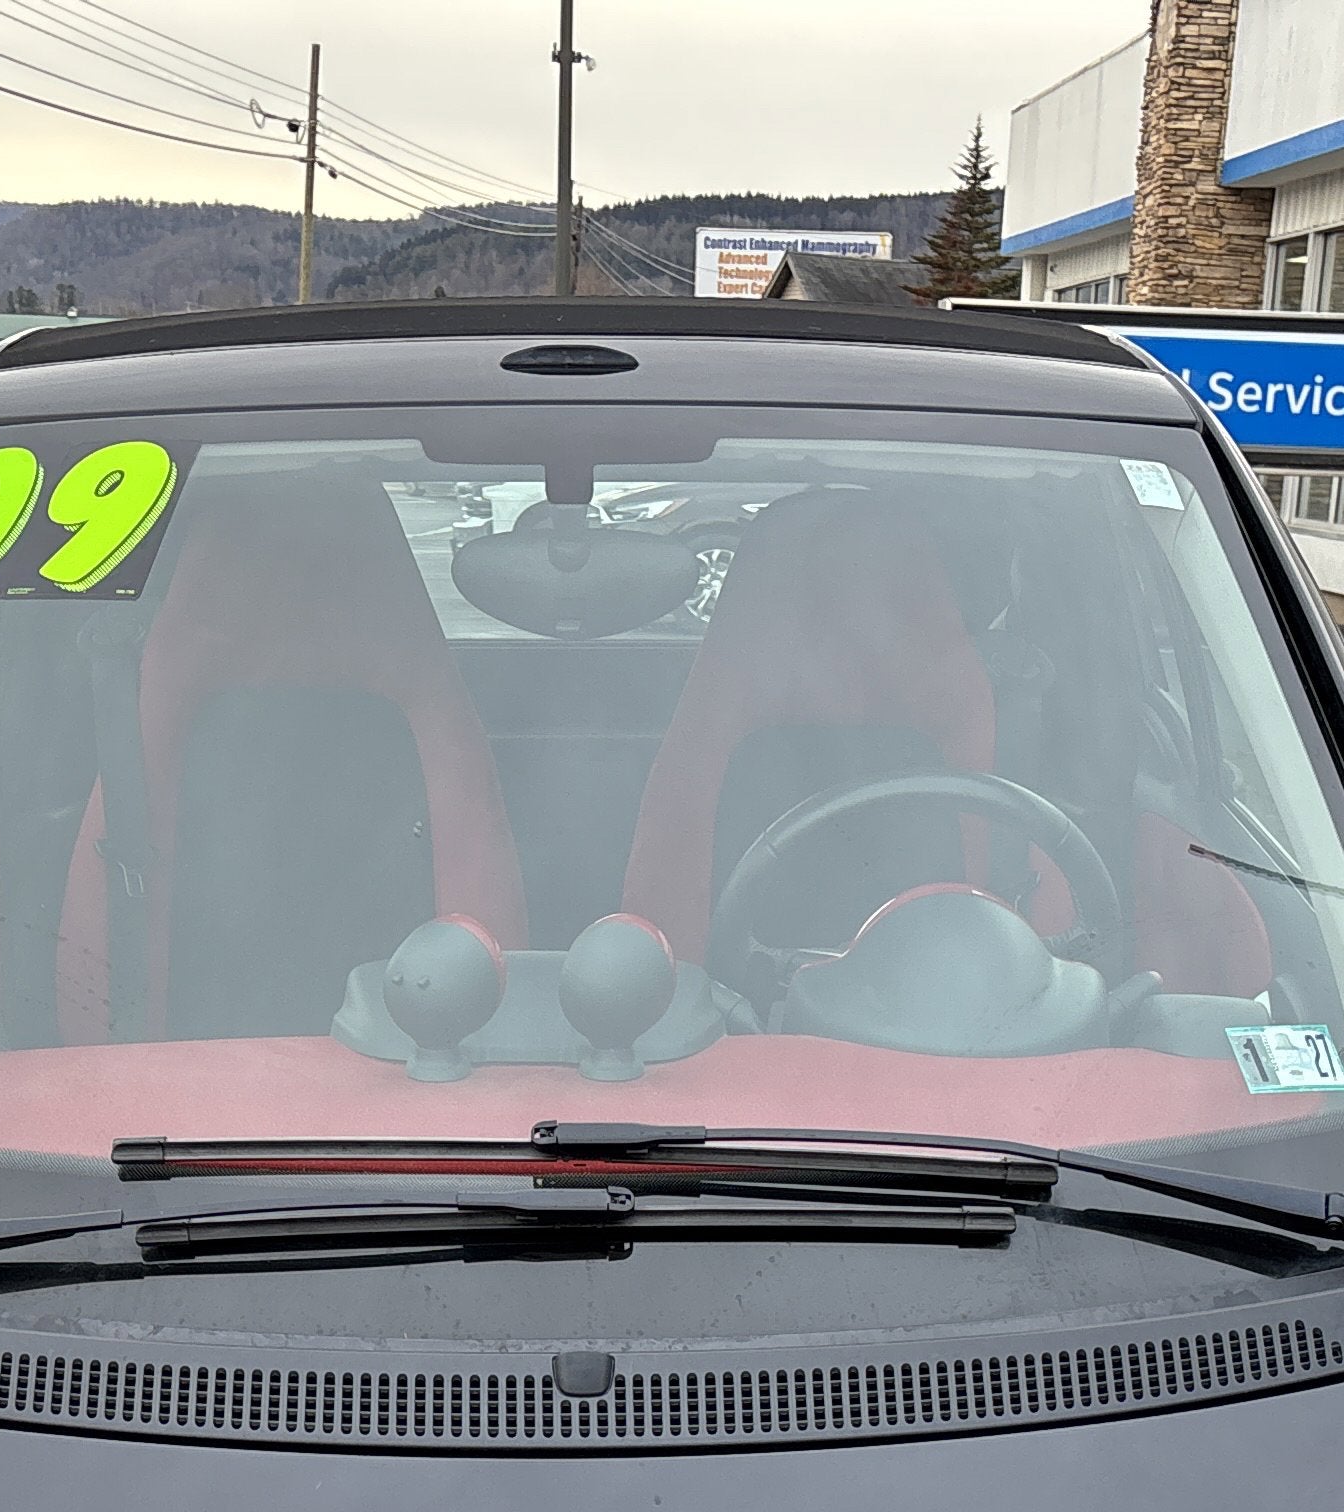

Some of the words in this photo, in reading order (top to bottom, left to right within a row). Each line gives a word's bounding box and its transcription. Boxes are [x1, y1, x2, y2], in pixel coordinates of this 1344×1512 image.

[704, 236, 747, 250] Contrast
[749, 238, 798, 251] Enhanced
[801, 239, 878, 255] Mammography
[719, 252, 768, 266] Advanced
[717, 281, 748, 294] Expert
[1243, 1038, 1269, 1082] 1
